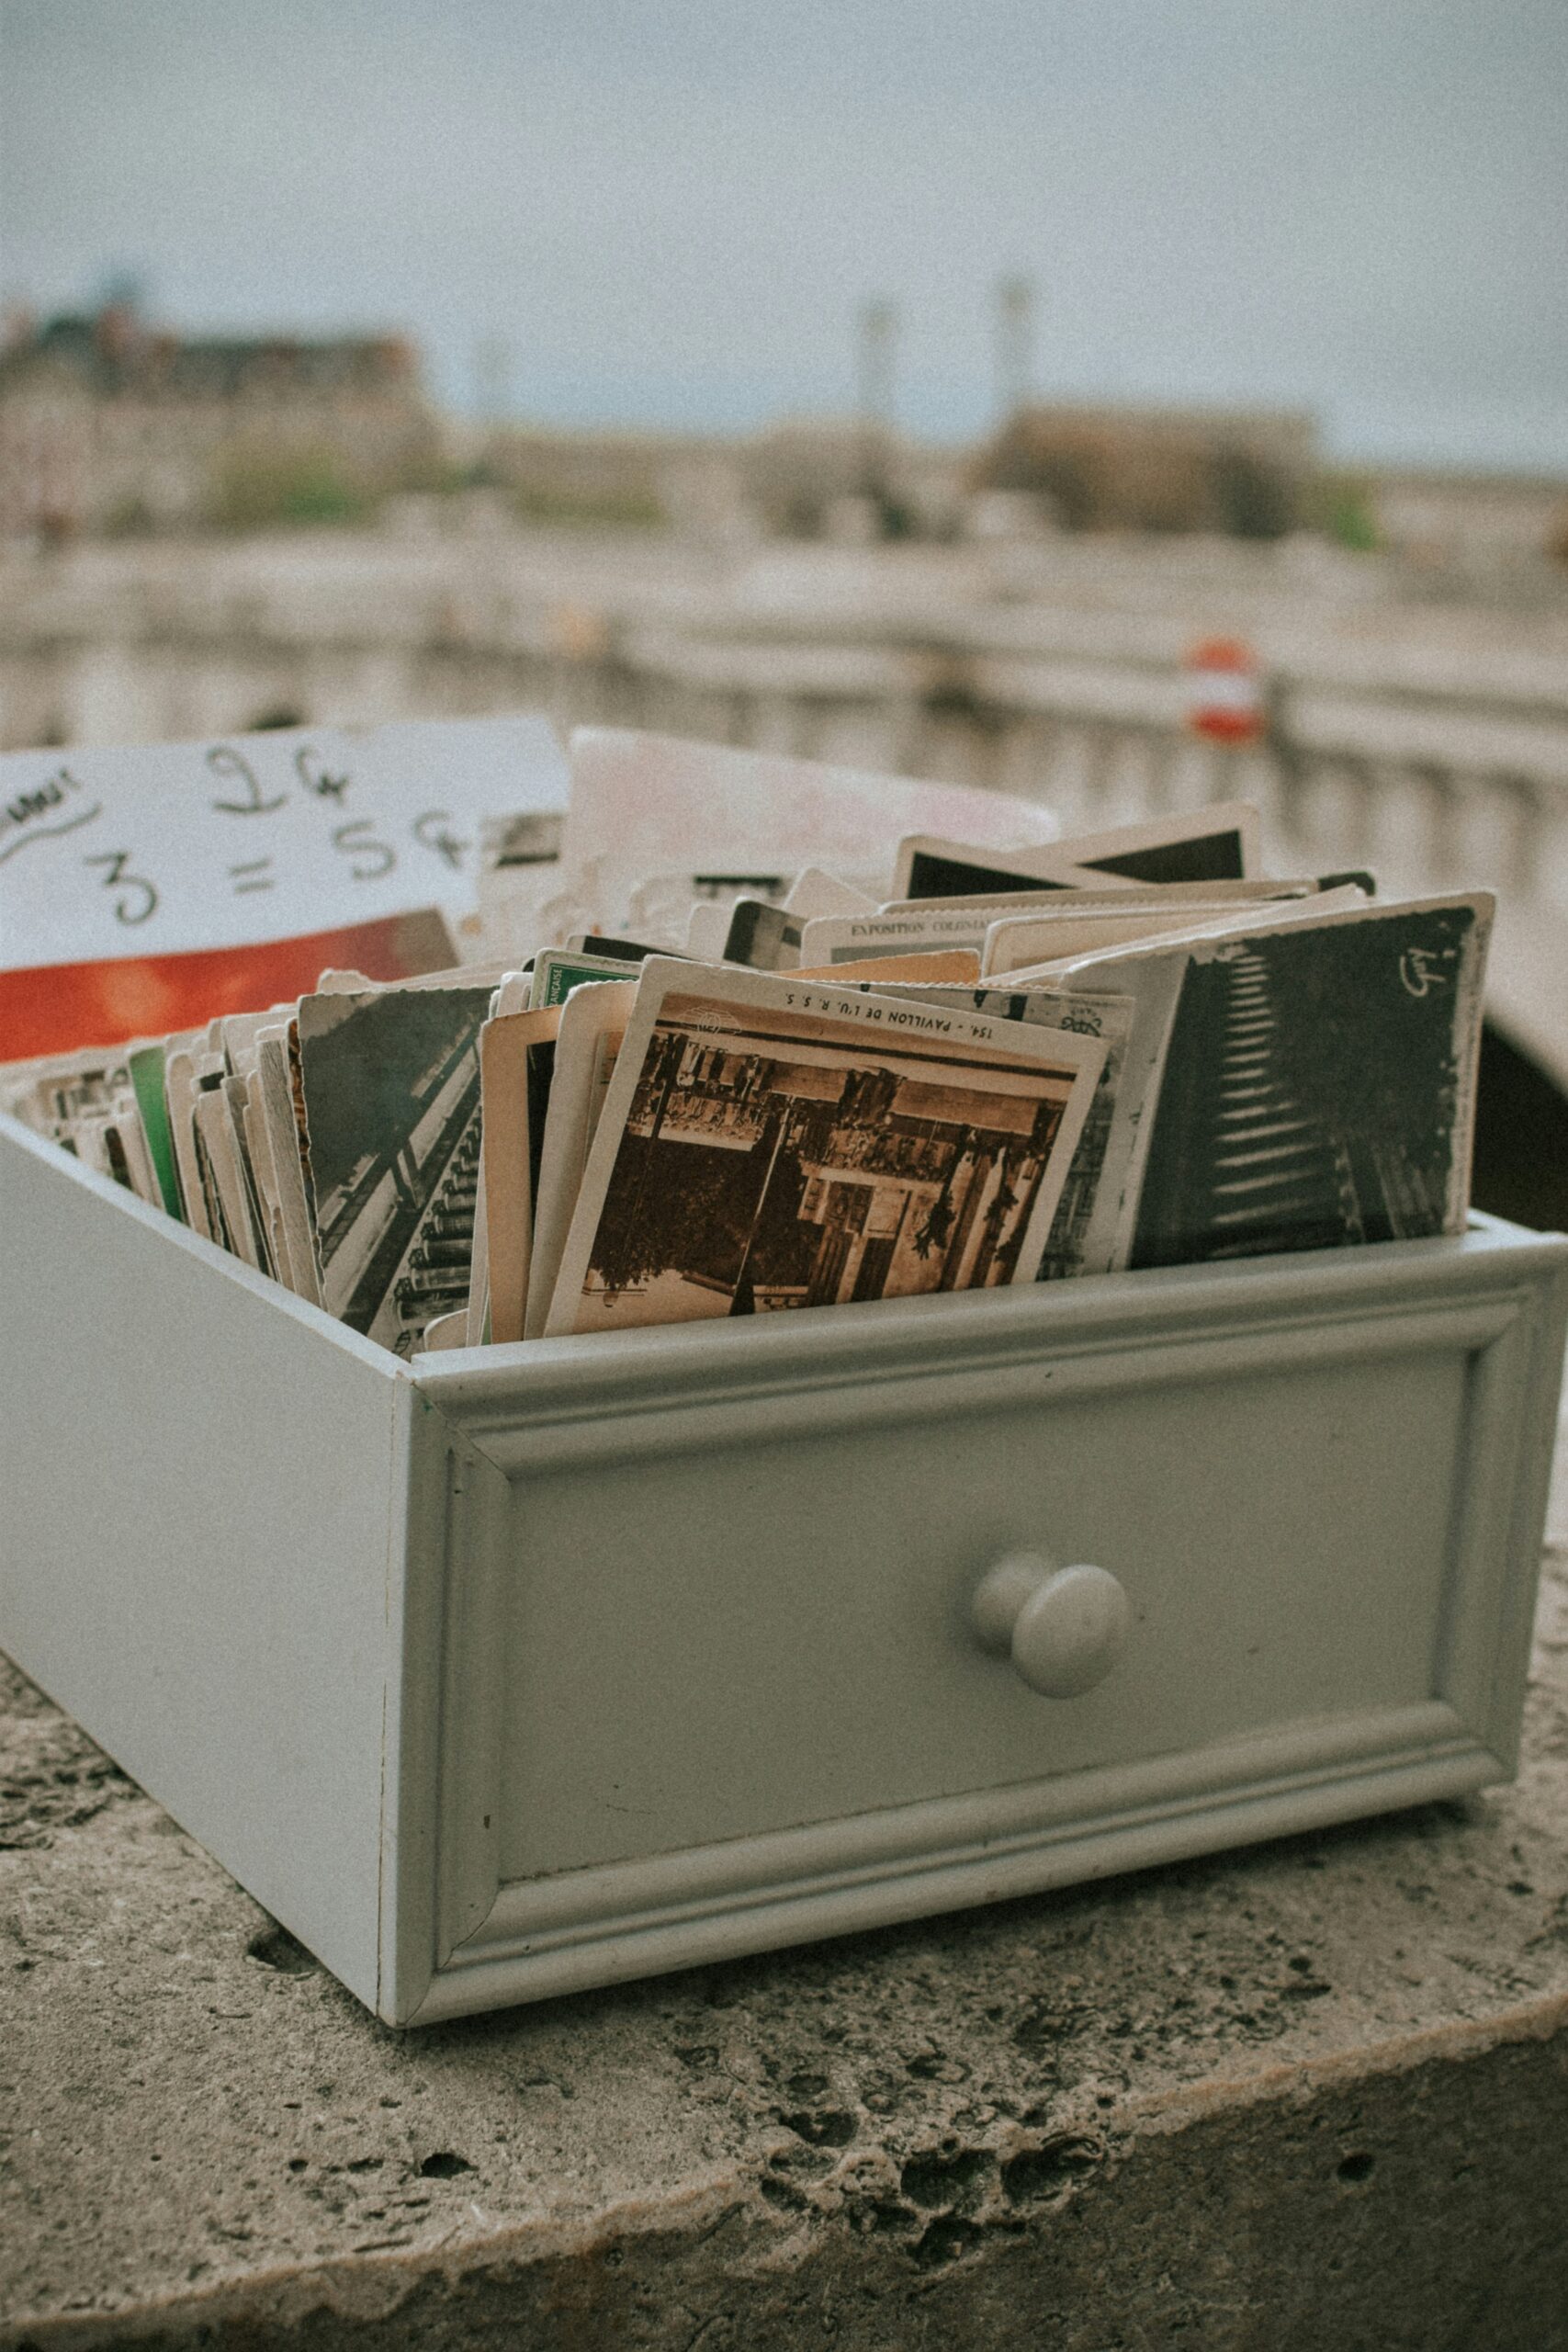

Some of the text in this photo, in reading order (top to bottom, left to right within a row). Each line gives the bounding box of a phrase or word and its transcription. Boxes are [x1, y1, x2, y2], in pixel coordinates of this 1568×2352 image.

[84, 850, 158, 927] 3
[852, 922, 924, 936] EXPOSITION
[865, 1007, 883, 1020] DE
[888, 1012, 952, 1032] PAVILLON
[971, 1025, 992, 1039] 154.
